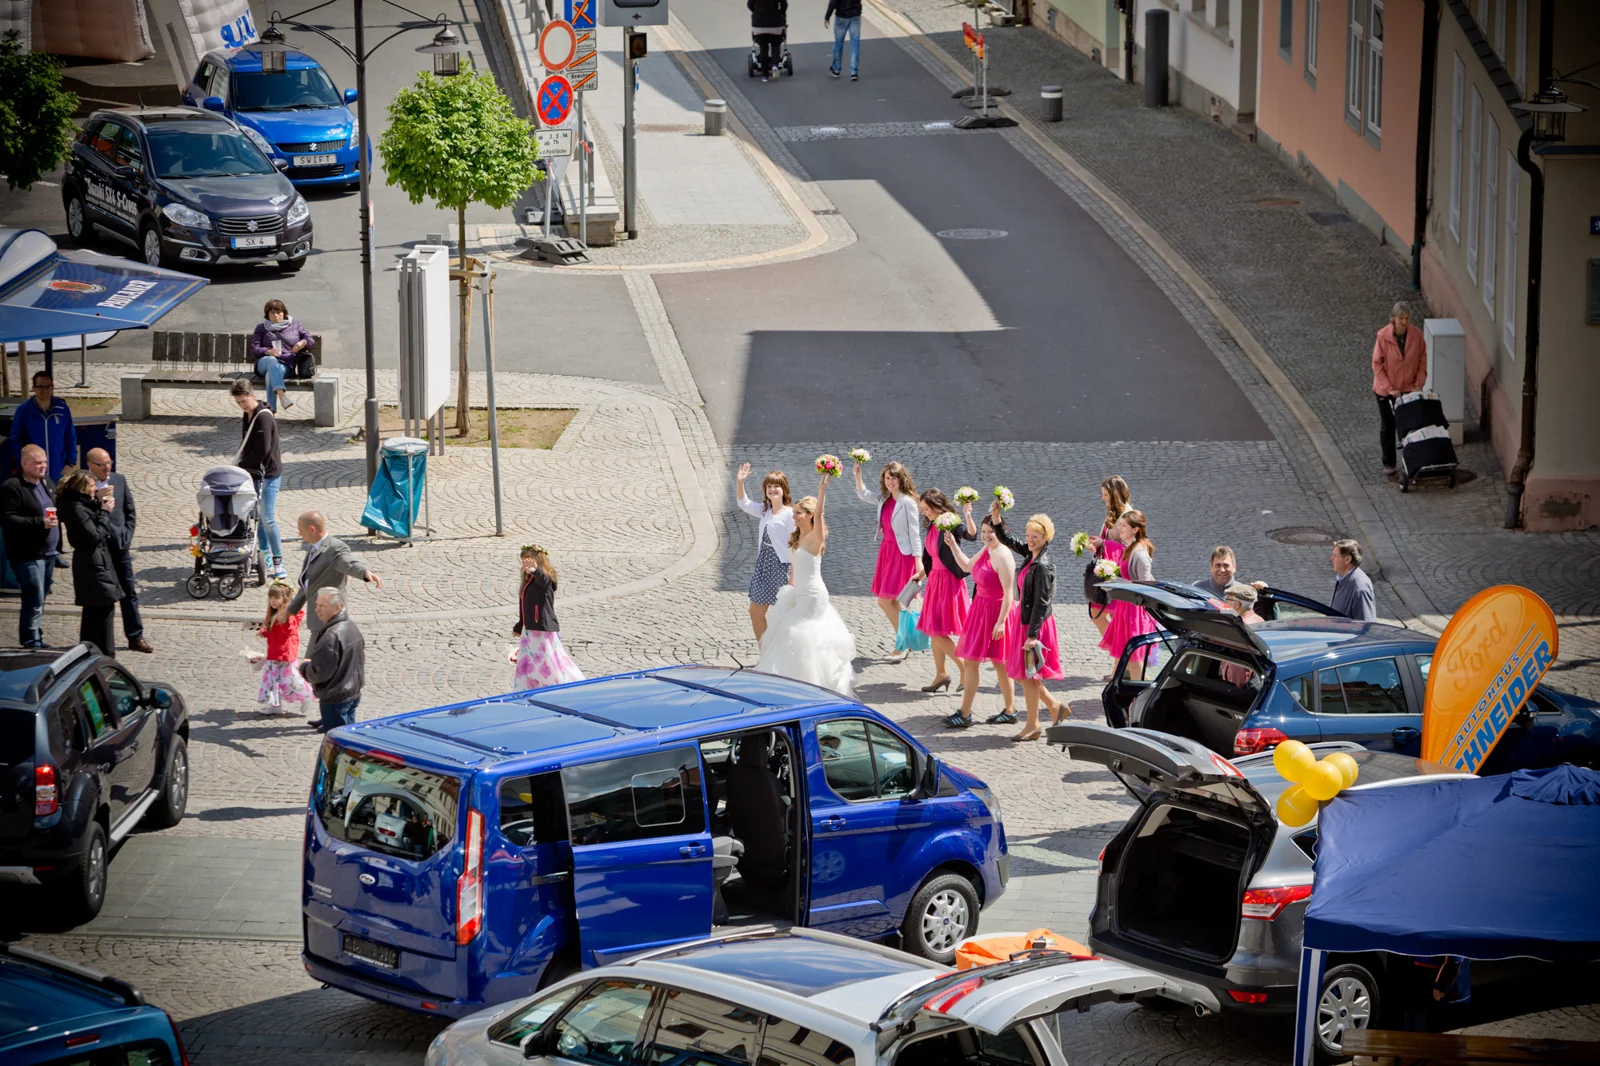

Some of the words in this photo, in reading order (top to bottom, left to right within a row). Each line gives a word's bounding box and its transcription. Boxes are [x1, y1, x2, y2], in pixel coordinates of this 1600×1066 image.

[300, 155, 331, 164] SWIFT
[116, 190, 137, 216] S-Cross
[245, 238, 256, 246] SX
[259, 237, 265, 245] 4
[96, 279, 159, 309] PAULANER
[1446, 610, 1508, 693] Ford
[1455, 653, 1520, 746] AUTOHAUS
